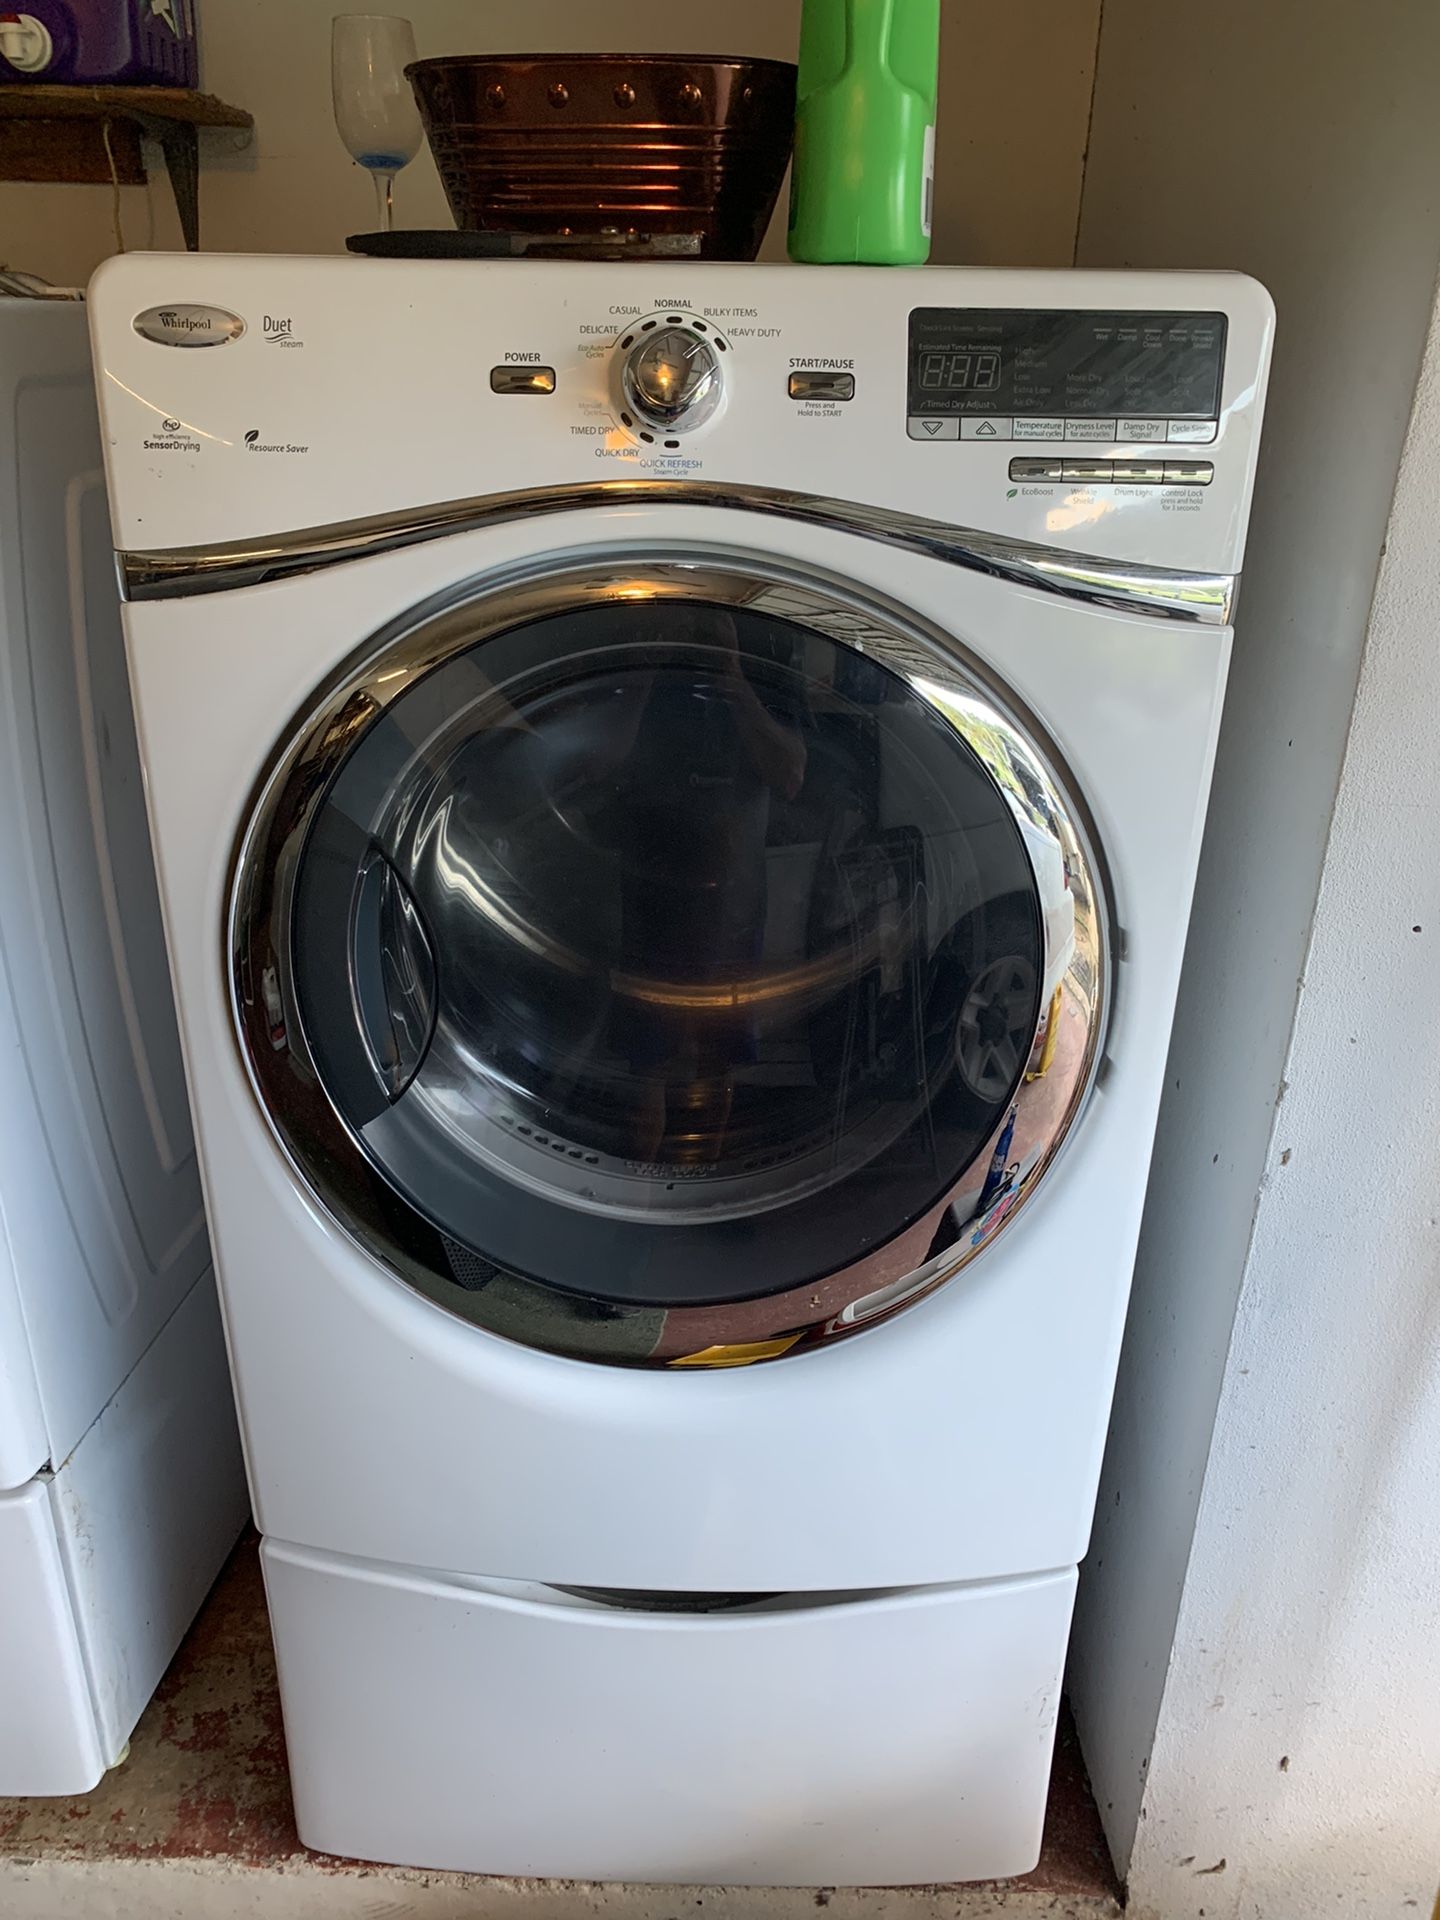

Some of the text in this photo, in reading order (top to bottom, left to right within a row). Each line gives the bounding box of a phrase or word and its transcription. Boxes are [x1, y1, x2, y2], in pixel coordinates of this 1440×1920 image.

[654, 299, 693, 309] NORMAL
[608, 305, 643, 316] CASUAL
[703, 307, 758, 318] BULKY ITEMS
[161, 317, 211, 332] Whirlpool
[263, 315, 292, 332] Duet
[579, 325, 618, 335] DELICATE
[727, 328, 782, 338] HEAVY DUTY
[280, 340, 304, 348] steam
[504, 353, 540, 362] POWER
[789, 358, 854, 369] START/PAUSE
[927, 400, 990, 409] Timed Dry Adjust
[1016, 420, 1062, 430] Temperature
[1066, 422, 1114, 431] Dryness Level
[1123, 423, 1160, 432] Damp Dry
[1171, 424, 1190, 433] Cycle
[570, 426, 615, 435] TIMED DRY
[1045, 430, 1062, 438] cycles
[1129, 431, 1152, 439] Signal
[143, 440, 201, 453] SensorDrying
[249, 443, 309, 453] Resource Saver
[594, 448, 640, 457] QUICK DRY
[639, 459, 703, 469] QUICK REFRESH
[1021, 488, 1054, 496] EcoBoost
[1114, 488, 1134, 496] Drum
[1161, 489, 1186, 497] Control
